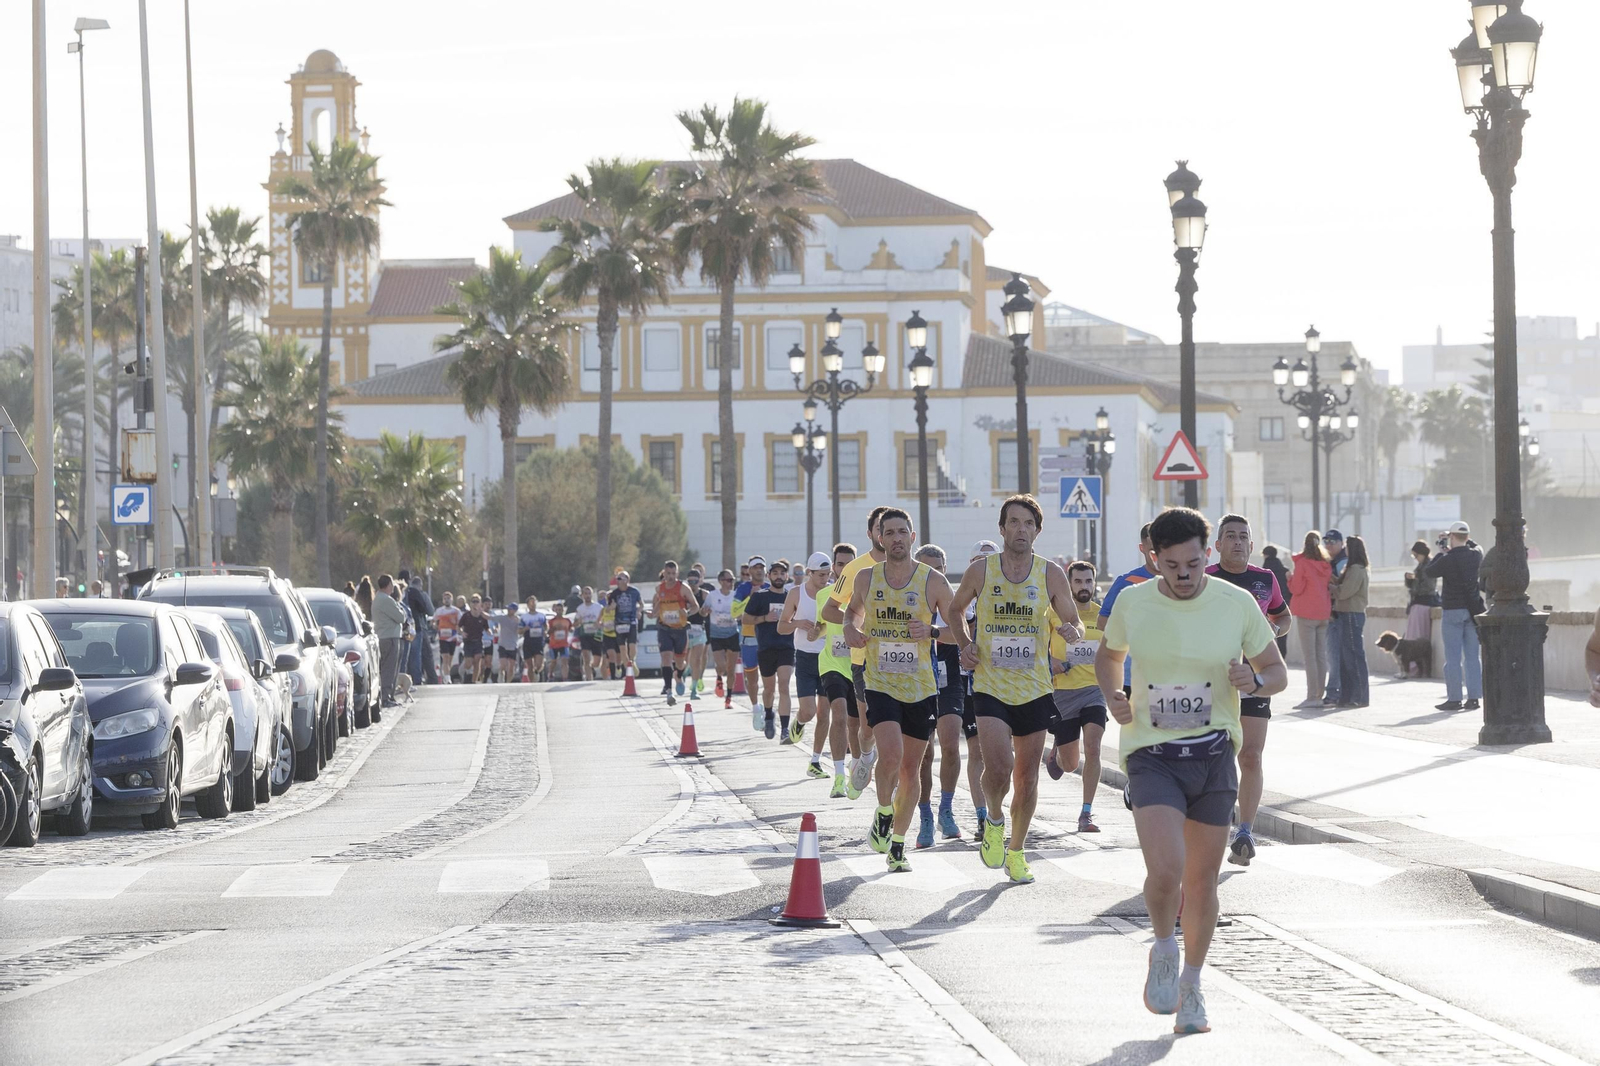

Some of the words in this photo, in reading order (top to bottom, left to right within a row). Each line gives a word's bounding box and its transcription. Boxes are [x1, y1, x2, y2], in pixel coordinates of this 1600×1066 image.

[870, 628, 898, 638] OLIMPO
[985, 624, 1017, 634] OLIMPO
[883, 651, 914, 663] 1929
[997, 646, 1030, 658] 1916
[1074, 647, 1092, 657] 530
[1157, 697, 1203, 714] 1192
